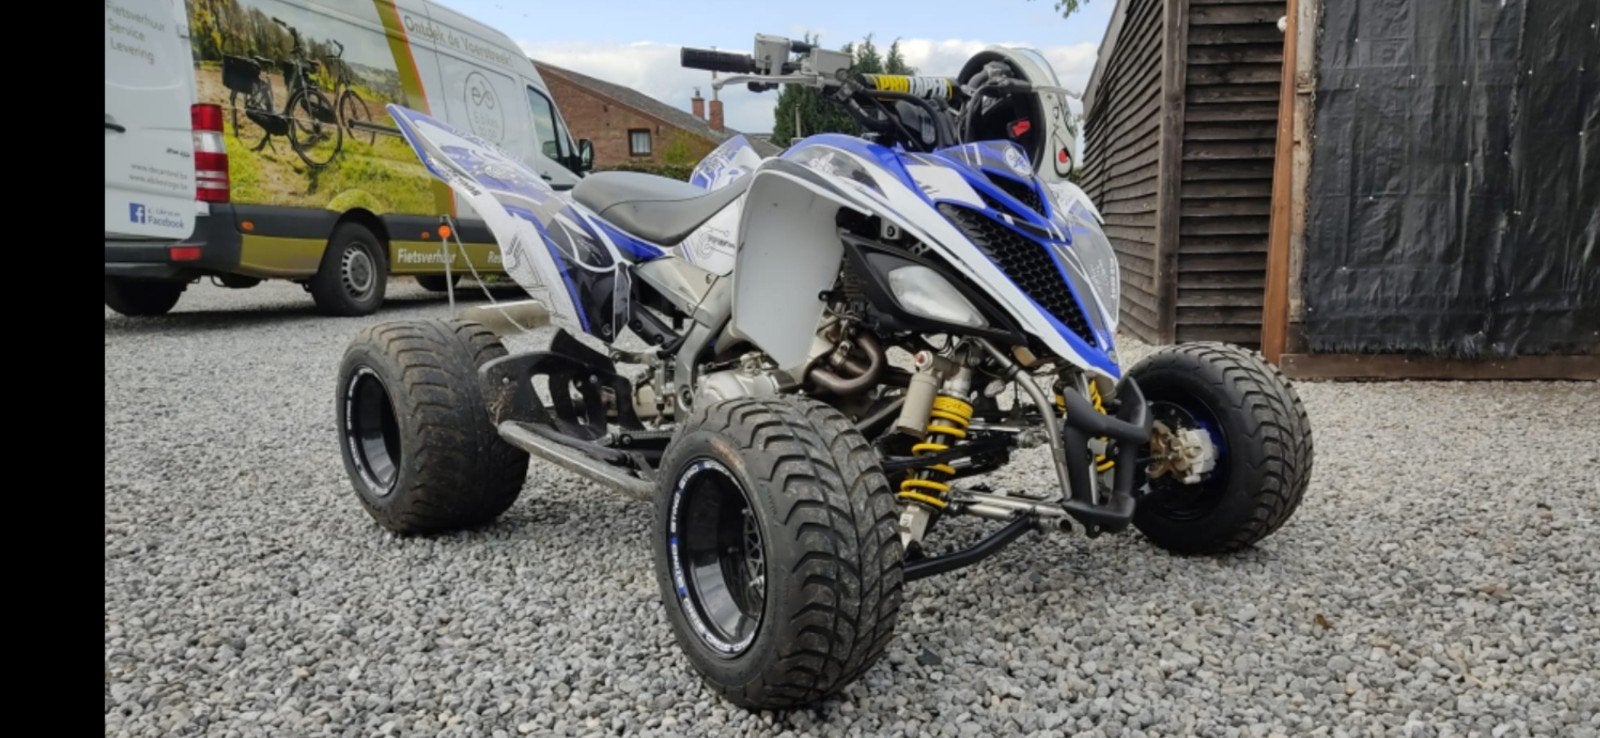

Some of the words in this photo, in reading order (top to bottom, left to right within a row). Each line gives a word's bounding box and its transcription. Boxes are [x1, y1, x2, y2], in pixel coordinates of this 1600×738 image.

[108, 18, 145, 41] Service
[110, 37, 155, 64] Levering
[879, 75, 908, 93] PRO
[148, 215, 184, 228] Facebook
